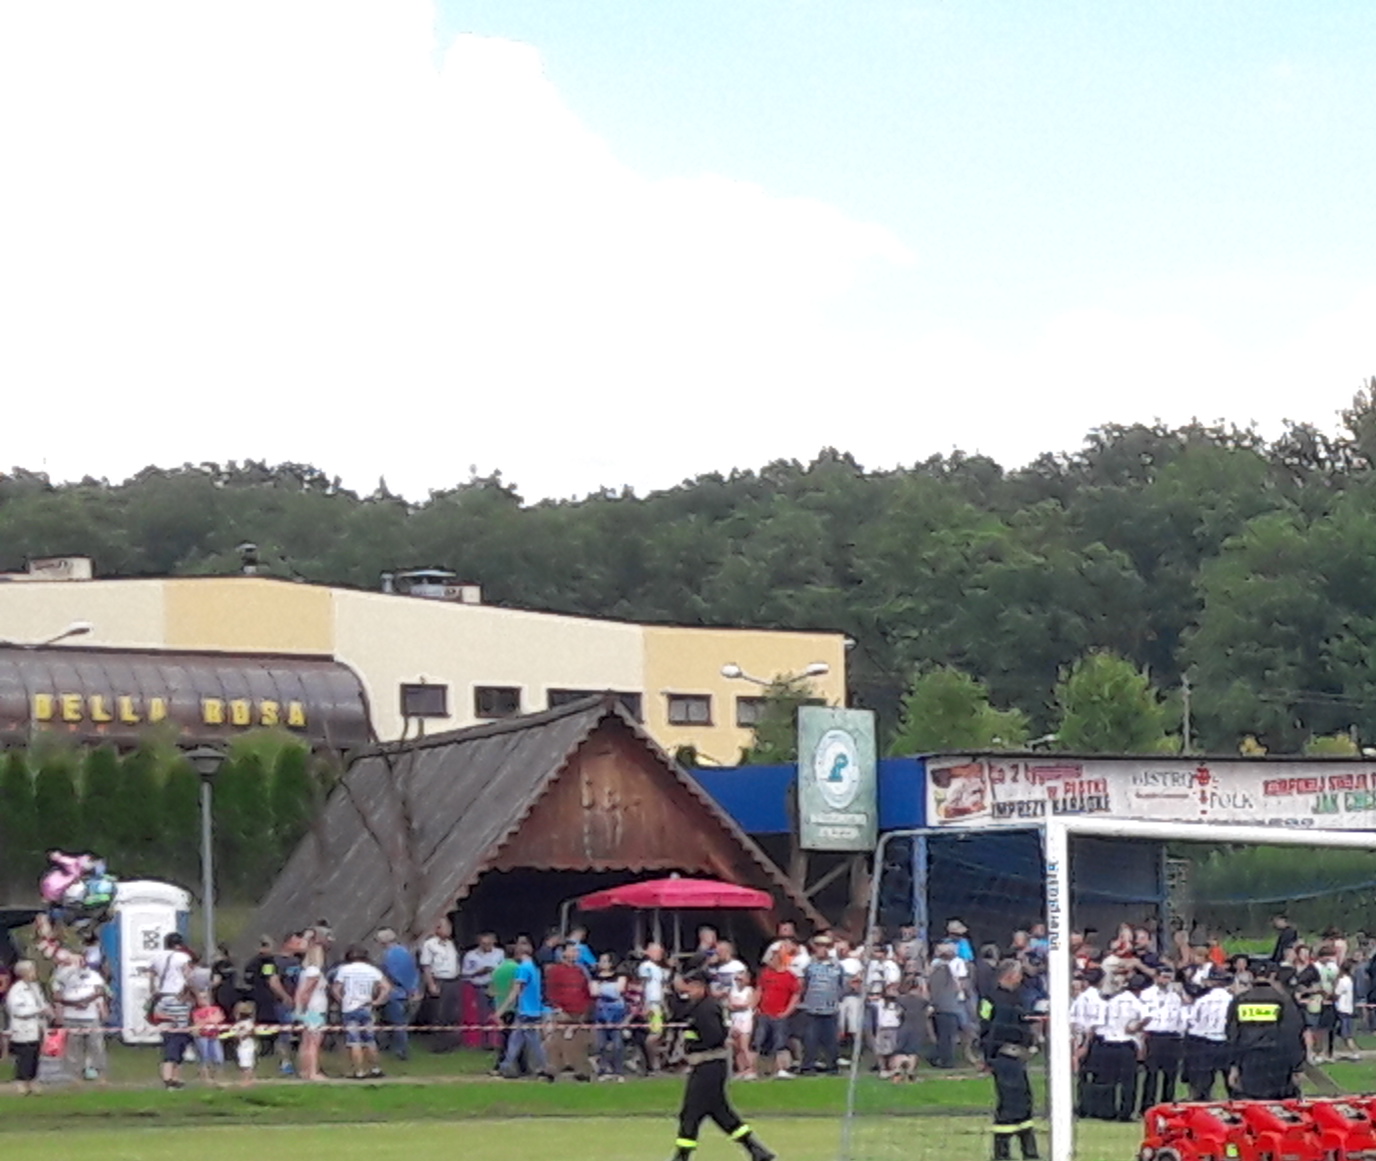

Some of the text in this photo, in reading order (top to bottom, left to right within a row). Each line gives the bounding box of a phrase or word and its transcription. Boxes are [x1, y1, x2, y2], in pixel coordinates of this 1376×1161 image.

[203, 697, 307, 727] ROSA
[1131, 771, 1193, 788] BISTRO
[1311, 793, 1340, 814] JAK
